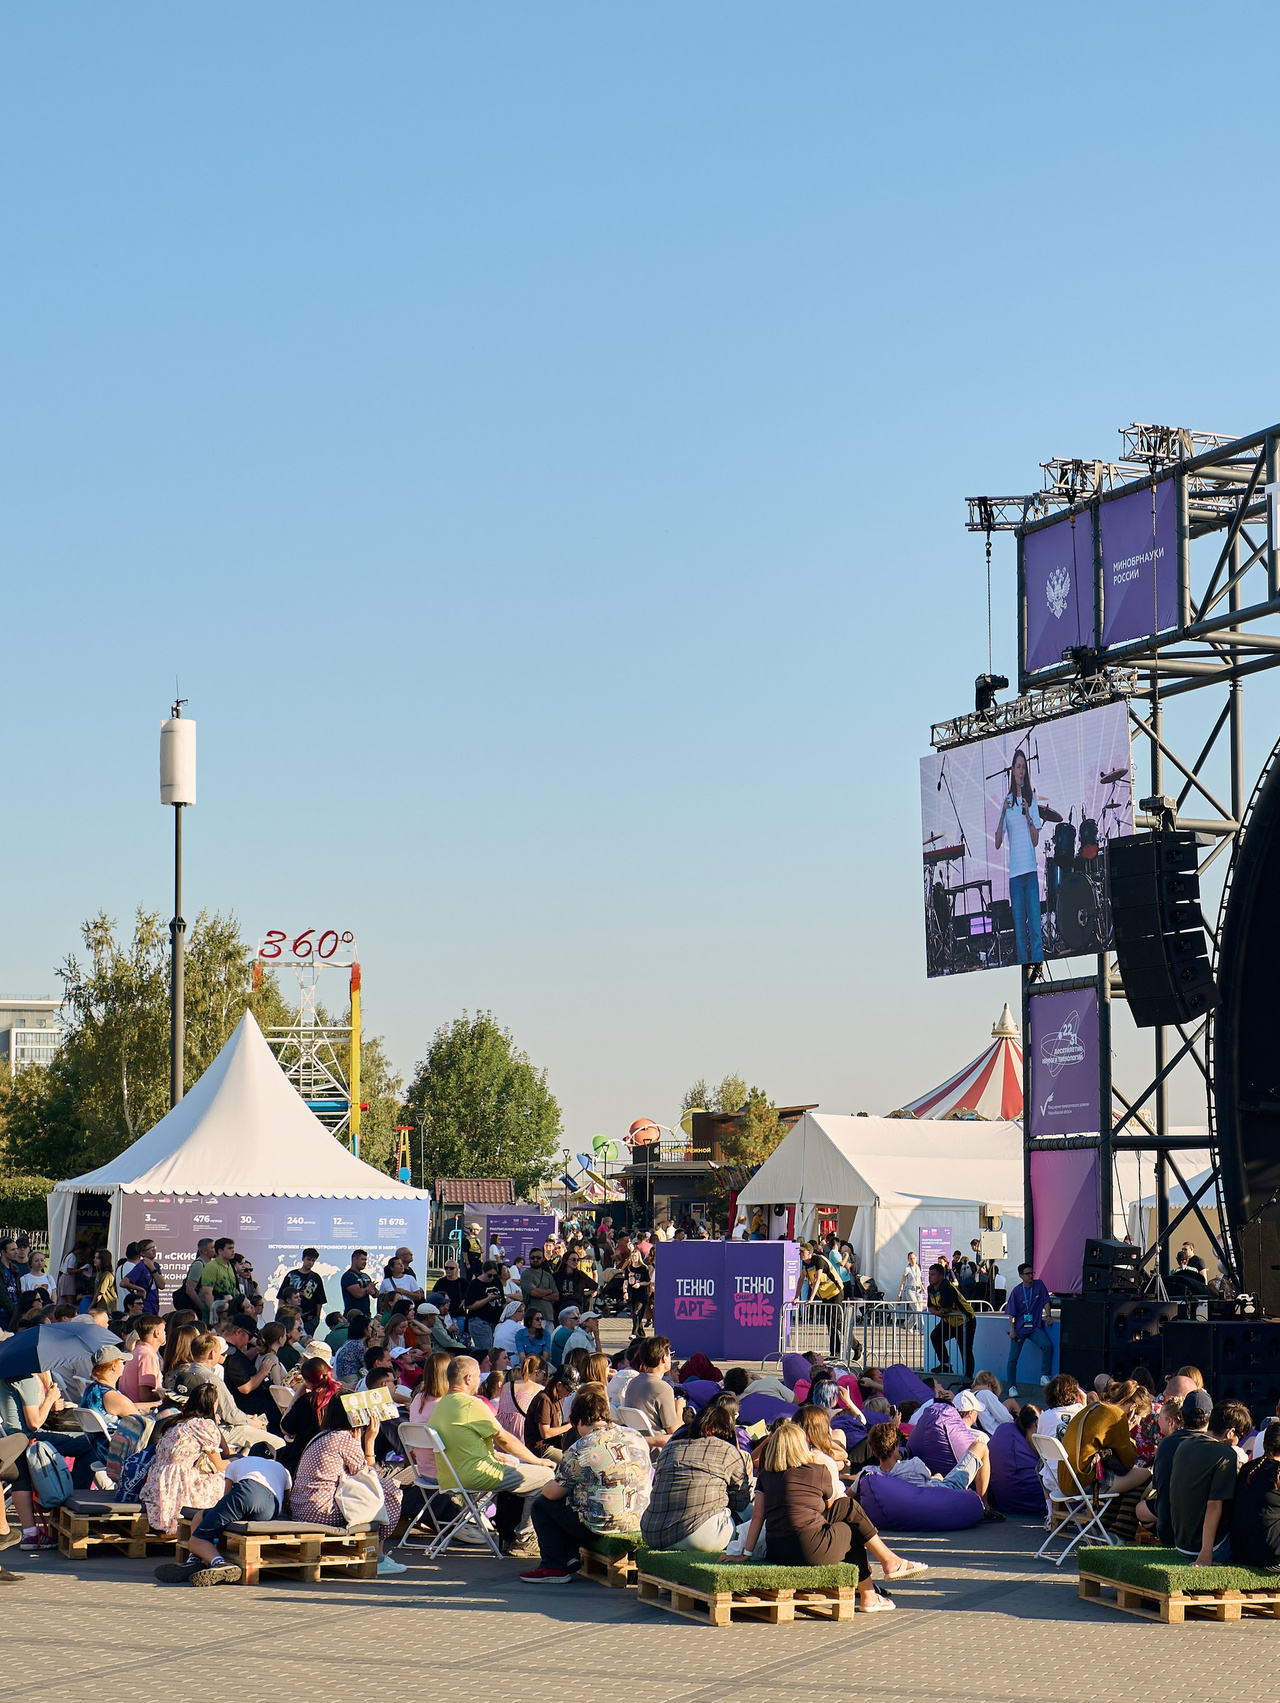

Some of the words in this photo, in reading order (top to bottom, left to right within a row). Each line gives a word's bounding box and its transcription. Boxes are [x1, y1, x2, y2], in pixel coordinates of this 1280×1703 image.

[1113, 547, 1165, 572] МИНОБРНАУКИ
[1113, 568, 1140, 585] РОССИИ
[1063, 1023, 1073, 1036] 22
[1070, 1033, 1078, 1045] 31
[145, 1214, 151, 1222] 3
[193, 1215, 210, 1223] 476
[240, 1216, 252, 1224] 30
[286, 1217, 304, 1225] 240
[333, 1217, 342, 1225] 12
[676, 1279, 715, 1296] ТЕХНО
[734, 1276, 775, 1294] ТЕХНО
[677, 1301, 706, 1317] АРТ
